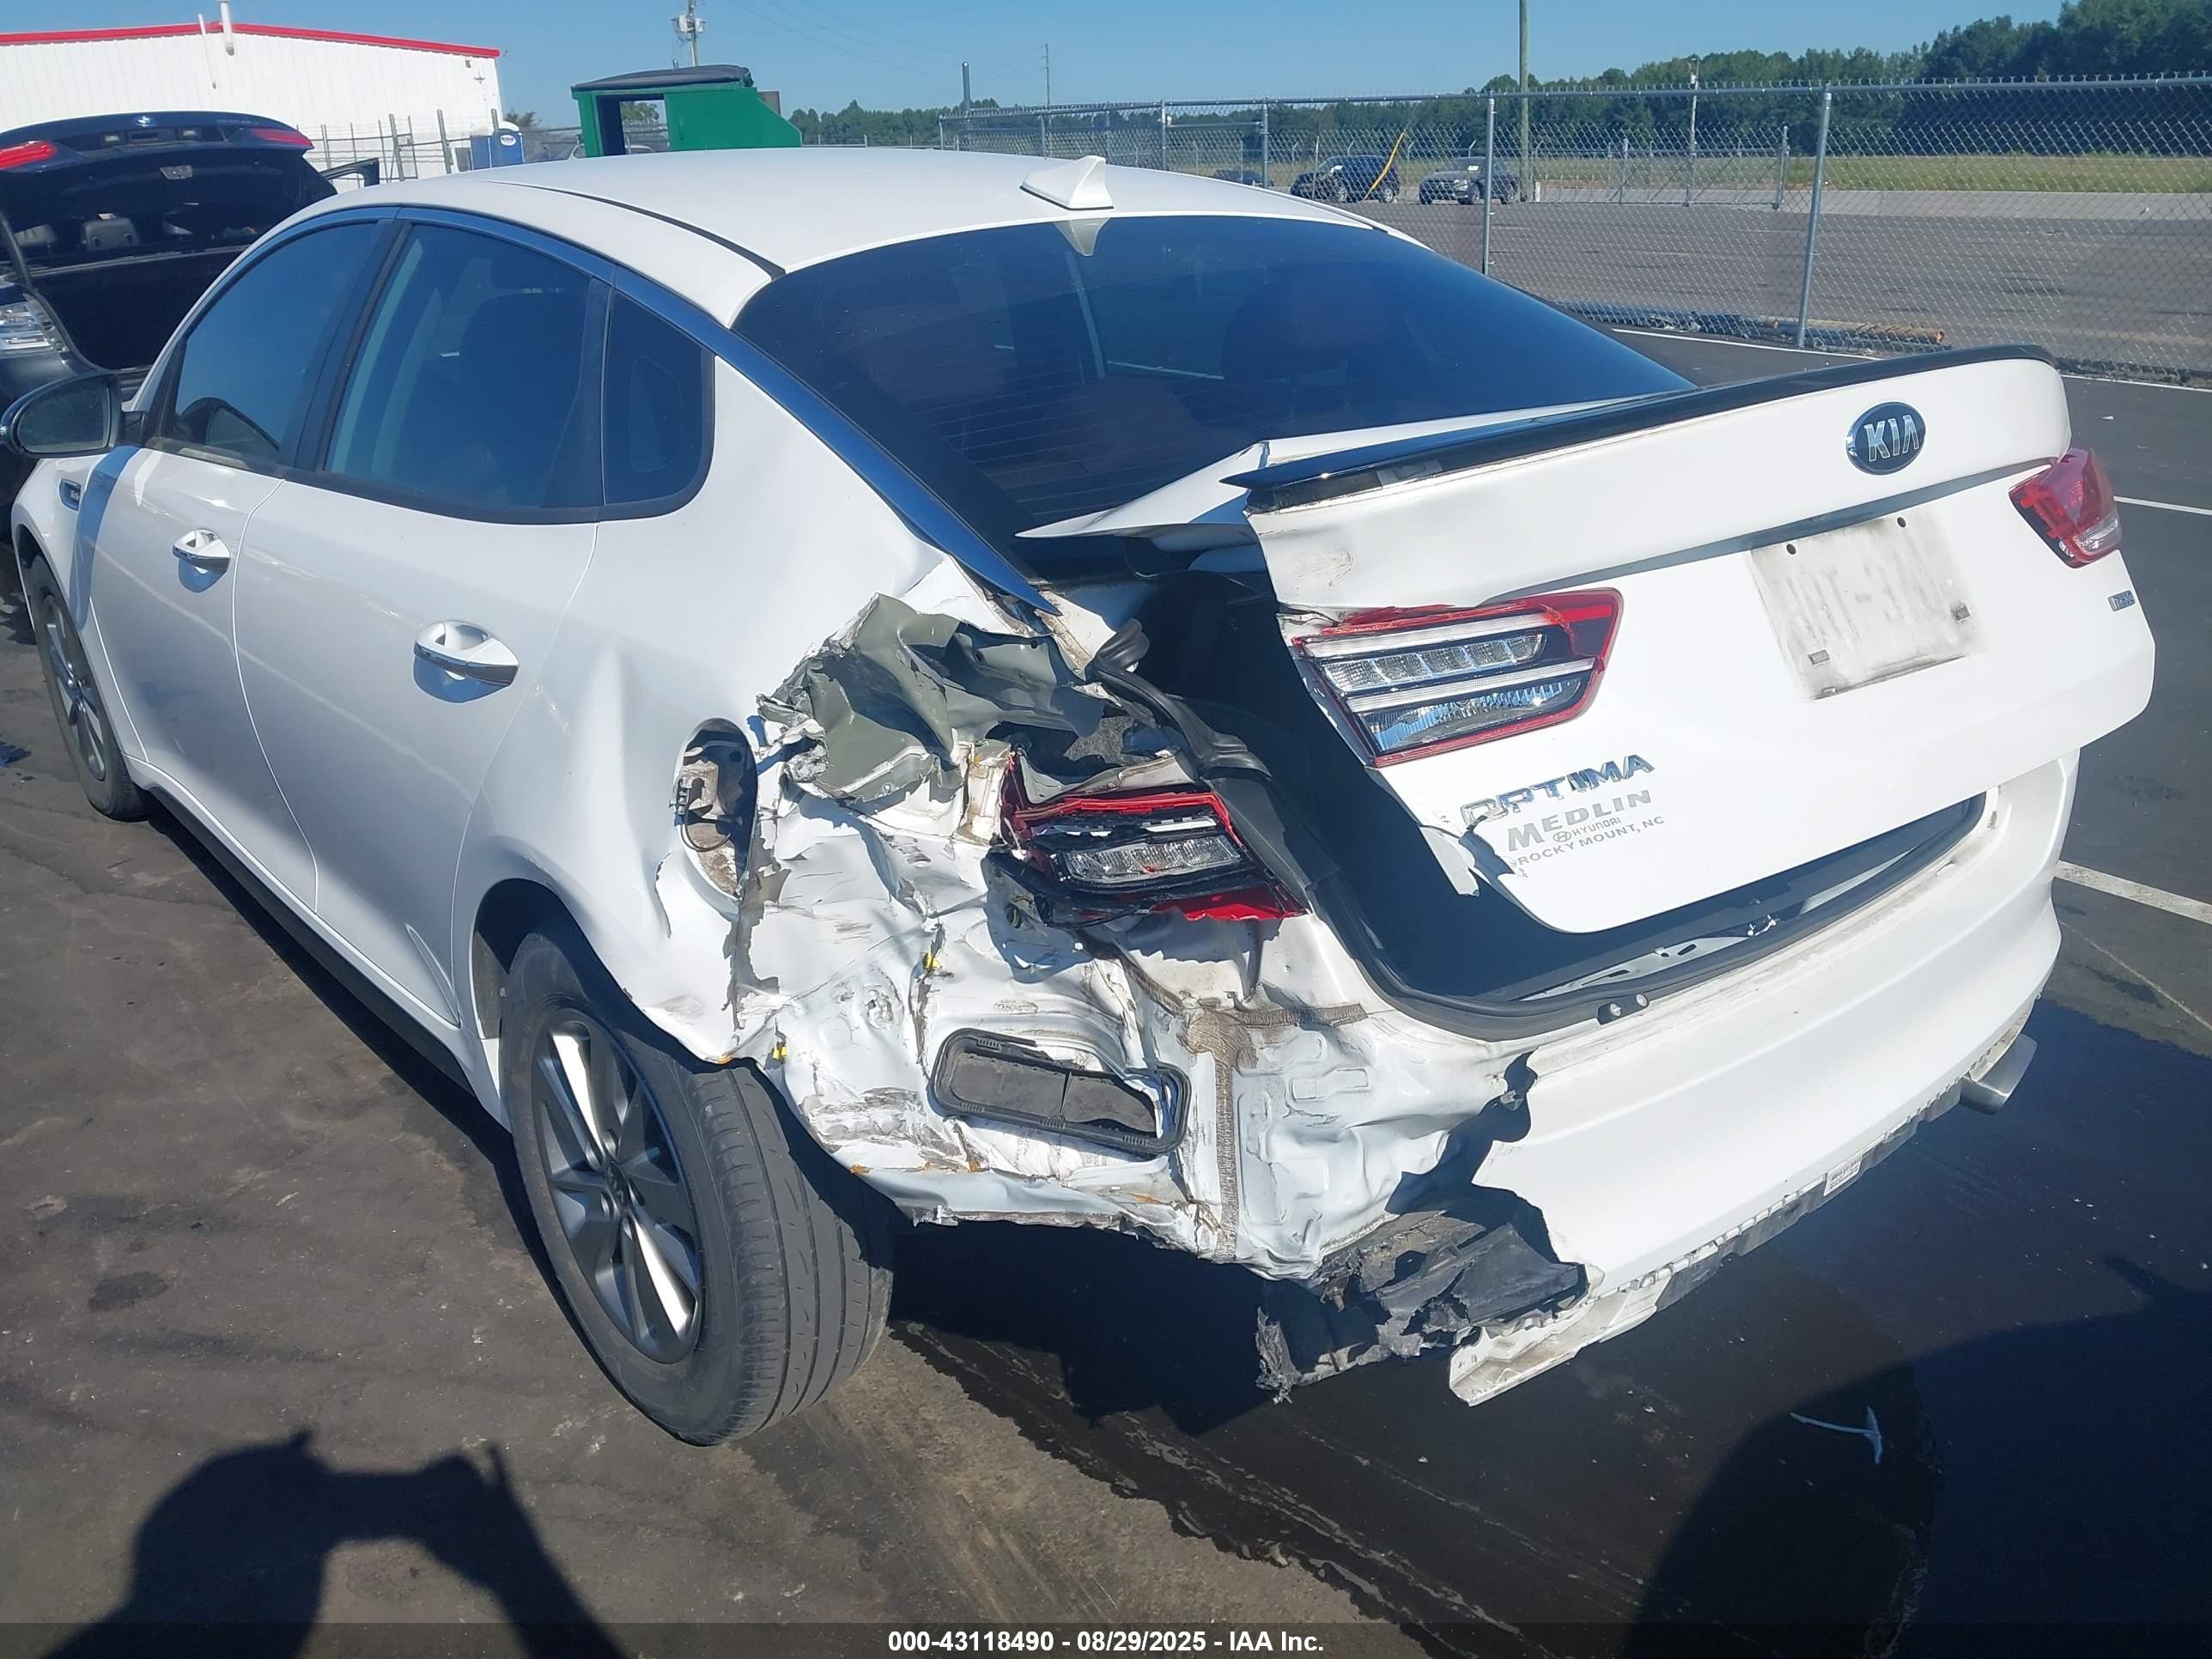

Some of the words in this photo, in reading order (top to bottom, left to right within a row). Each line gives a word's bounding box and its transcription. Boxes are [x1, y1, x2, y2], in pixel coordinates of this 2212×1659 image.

[1864, 415, 1920, 462] KIA
[1460, 754, 1656, 830] OPTIMA
[1507, 790, 1651, 852] MEDLIN
[1517, 842, 1574, 866] ROCKY
[1578, 823, 1641, 847] MOUNT,
[1641, 816, 1665, 829] NC
[1571, 817, 1621, 837] HYUNDAI
